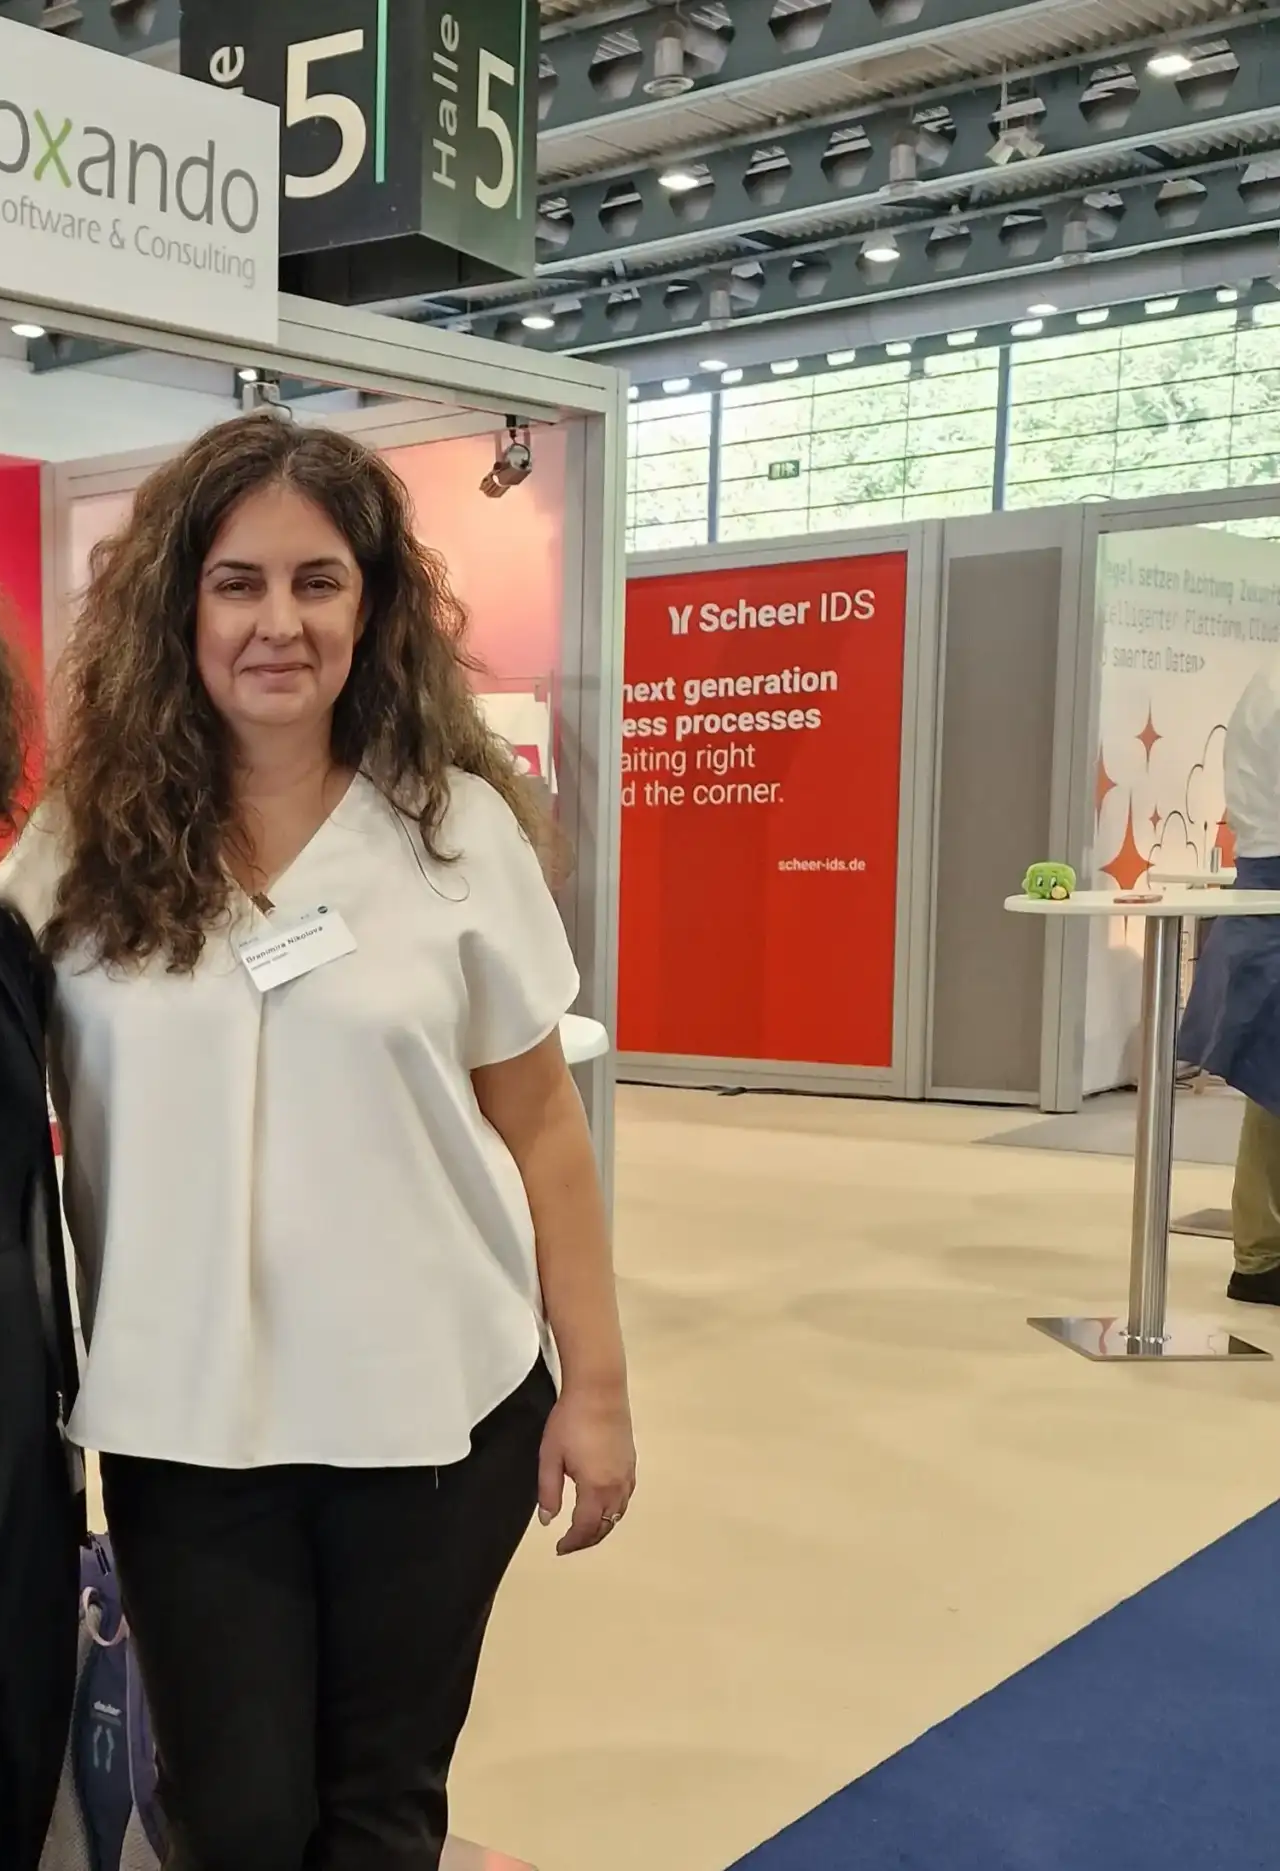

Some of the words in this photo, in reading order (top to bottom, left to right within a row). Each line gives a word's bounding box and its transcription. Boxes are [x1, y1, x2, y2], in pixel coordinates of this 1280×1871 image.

[285, 29, 366, 197] 5
[433, 14, 459, 190] Halle
[476, 49, 514, 209] 5
[108, 218, 125, 250] &
[134, 224, 256, 289] Consulting
[700, 599, 810, 631] Scheer
[821, 590, 874, 622] IDS
[624, 677, 675, 702] next
[684, 667, 837, 705] generation
[624, 717, 667, 737] ess
[676, 708, 820, 741] processes
[697, 742, 755, 775] right
[644, 781, 684, 805] the
[694, 780, 783, 804] corner.
[779, 858, 865, 870] scheer-ids.de
